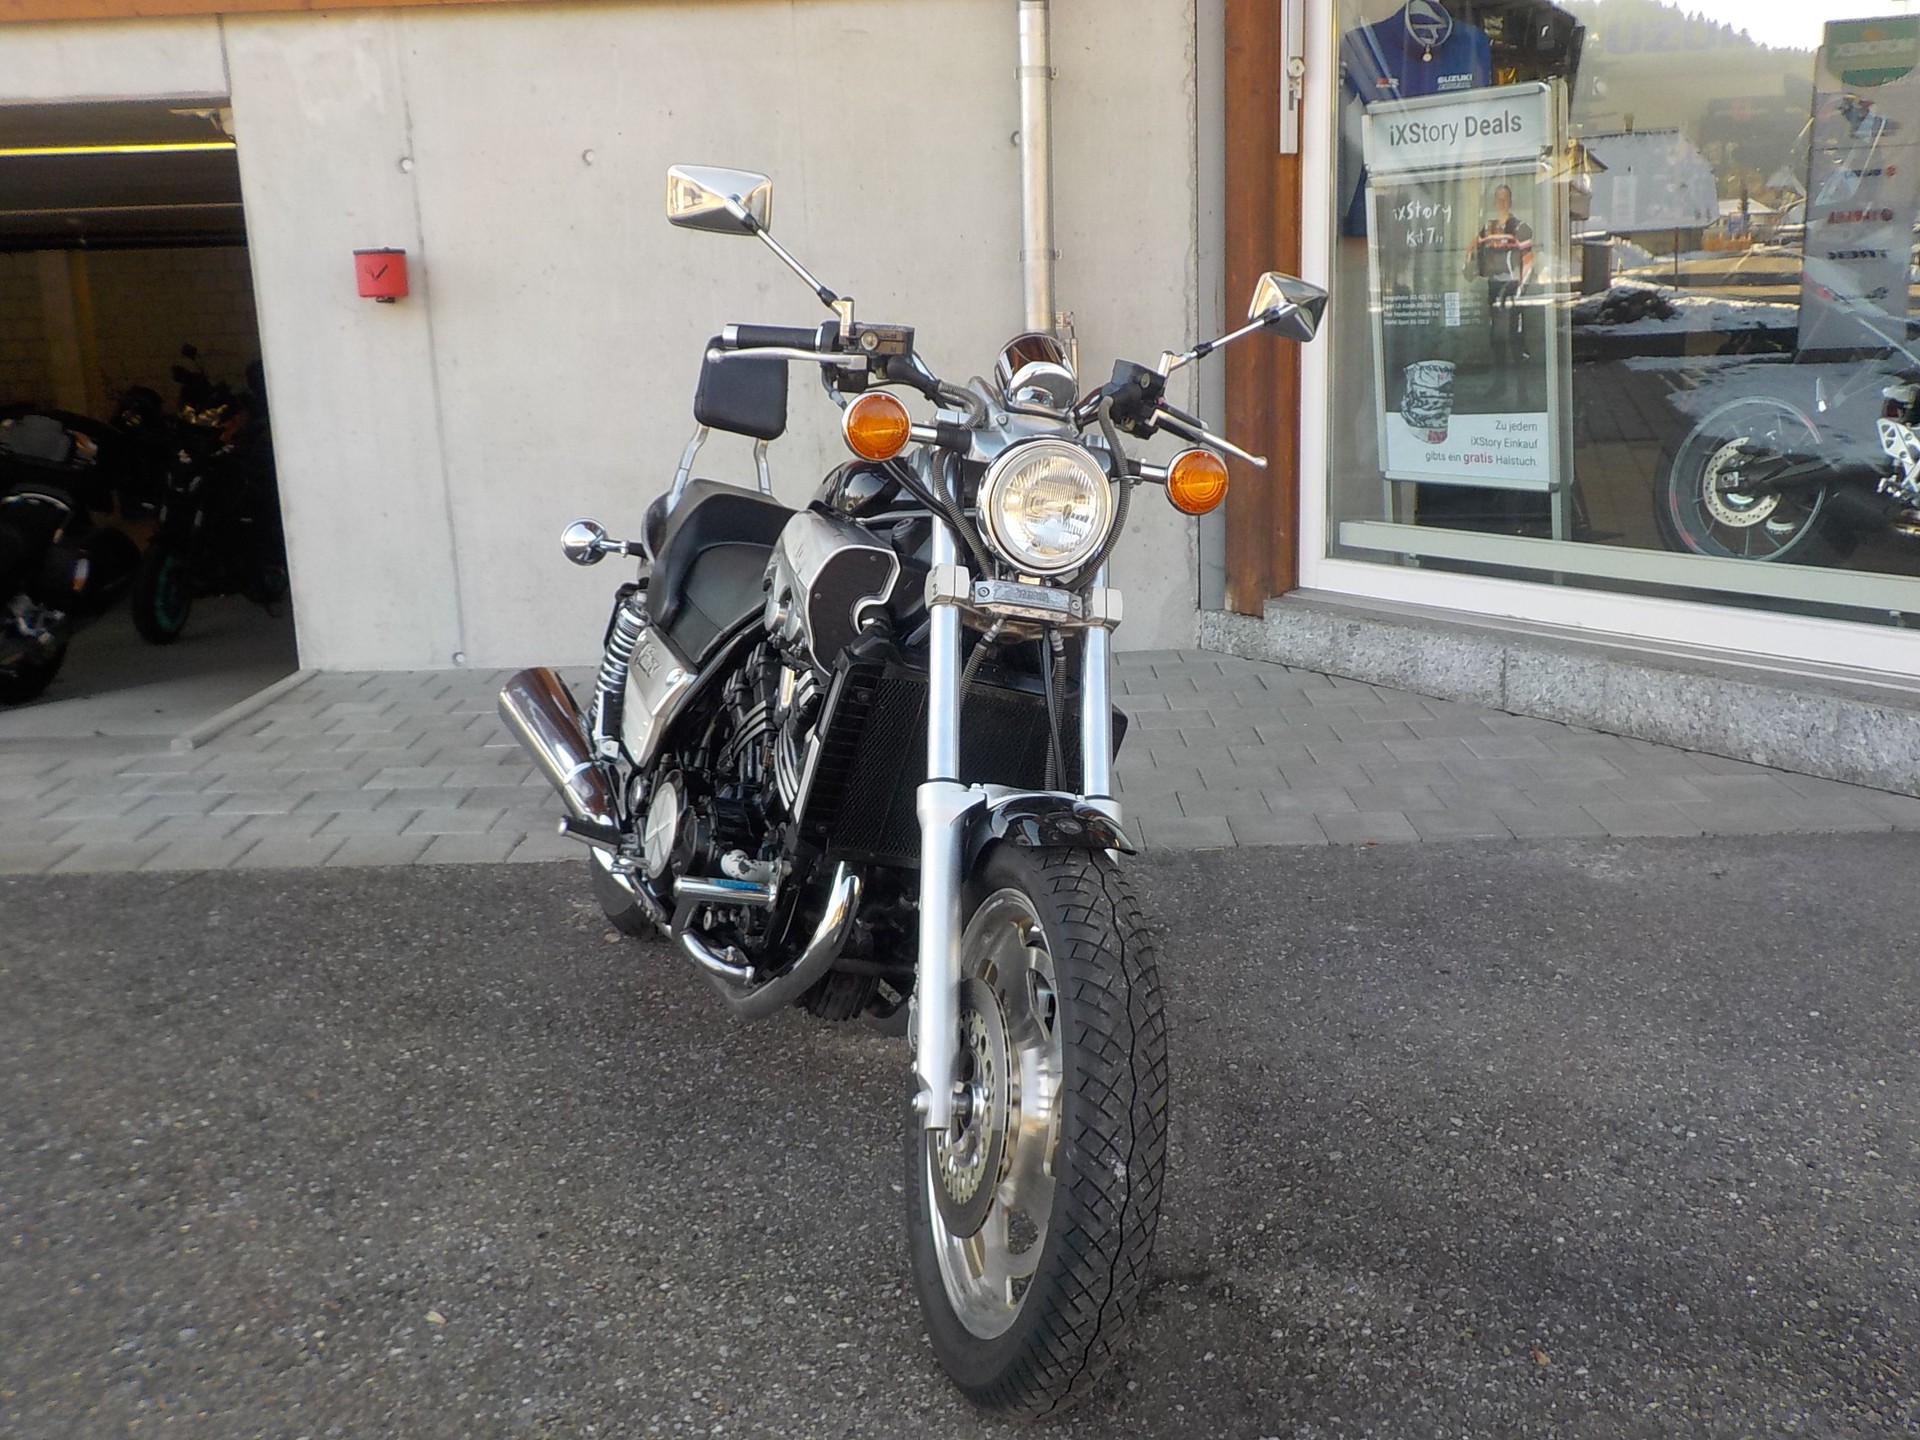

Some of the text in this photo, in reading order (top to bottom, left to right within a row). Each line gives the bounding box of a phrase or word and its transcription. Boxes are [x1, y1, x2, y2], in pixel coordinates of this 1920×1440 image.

[1437, 73, 1473, 84] SUZUKI
[1389, 110, 1522, 146] iXStory Deals
[1495, 420, 1538, 433] Zu jedem
[1470, 436, 1538, 449] iXStory Einkauf
[1425, 451, 1446, 462] gibts
[1448, 453, 1461, 462] ein
[1463, 451, 1493, 465] gratis
